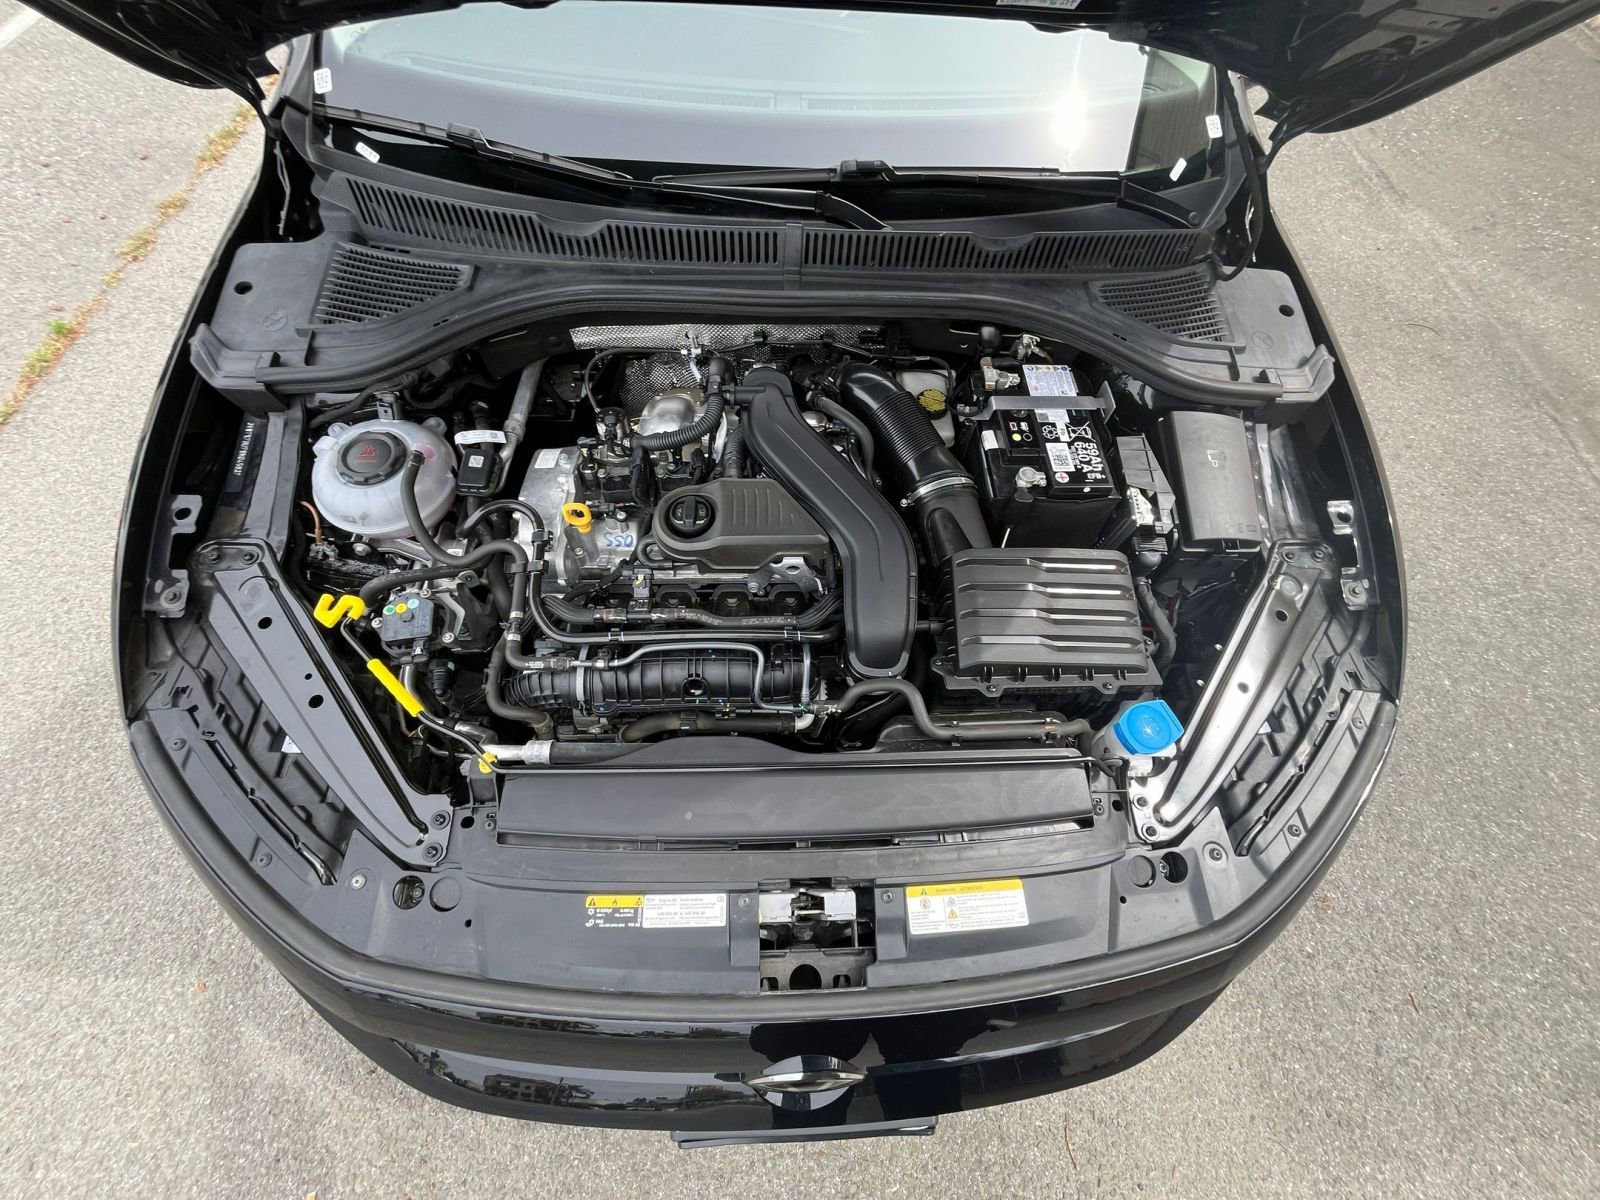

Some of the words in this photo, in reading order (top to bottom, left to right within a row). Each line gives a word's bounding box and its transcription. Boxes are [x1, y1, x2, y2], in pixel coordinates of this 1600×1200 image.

[1074, 441, 1090, 461] 640
[1085, 442, 1104, 471] 59Ah
[1080, 463, 1094, 473] A
